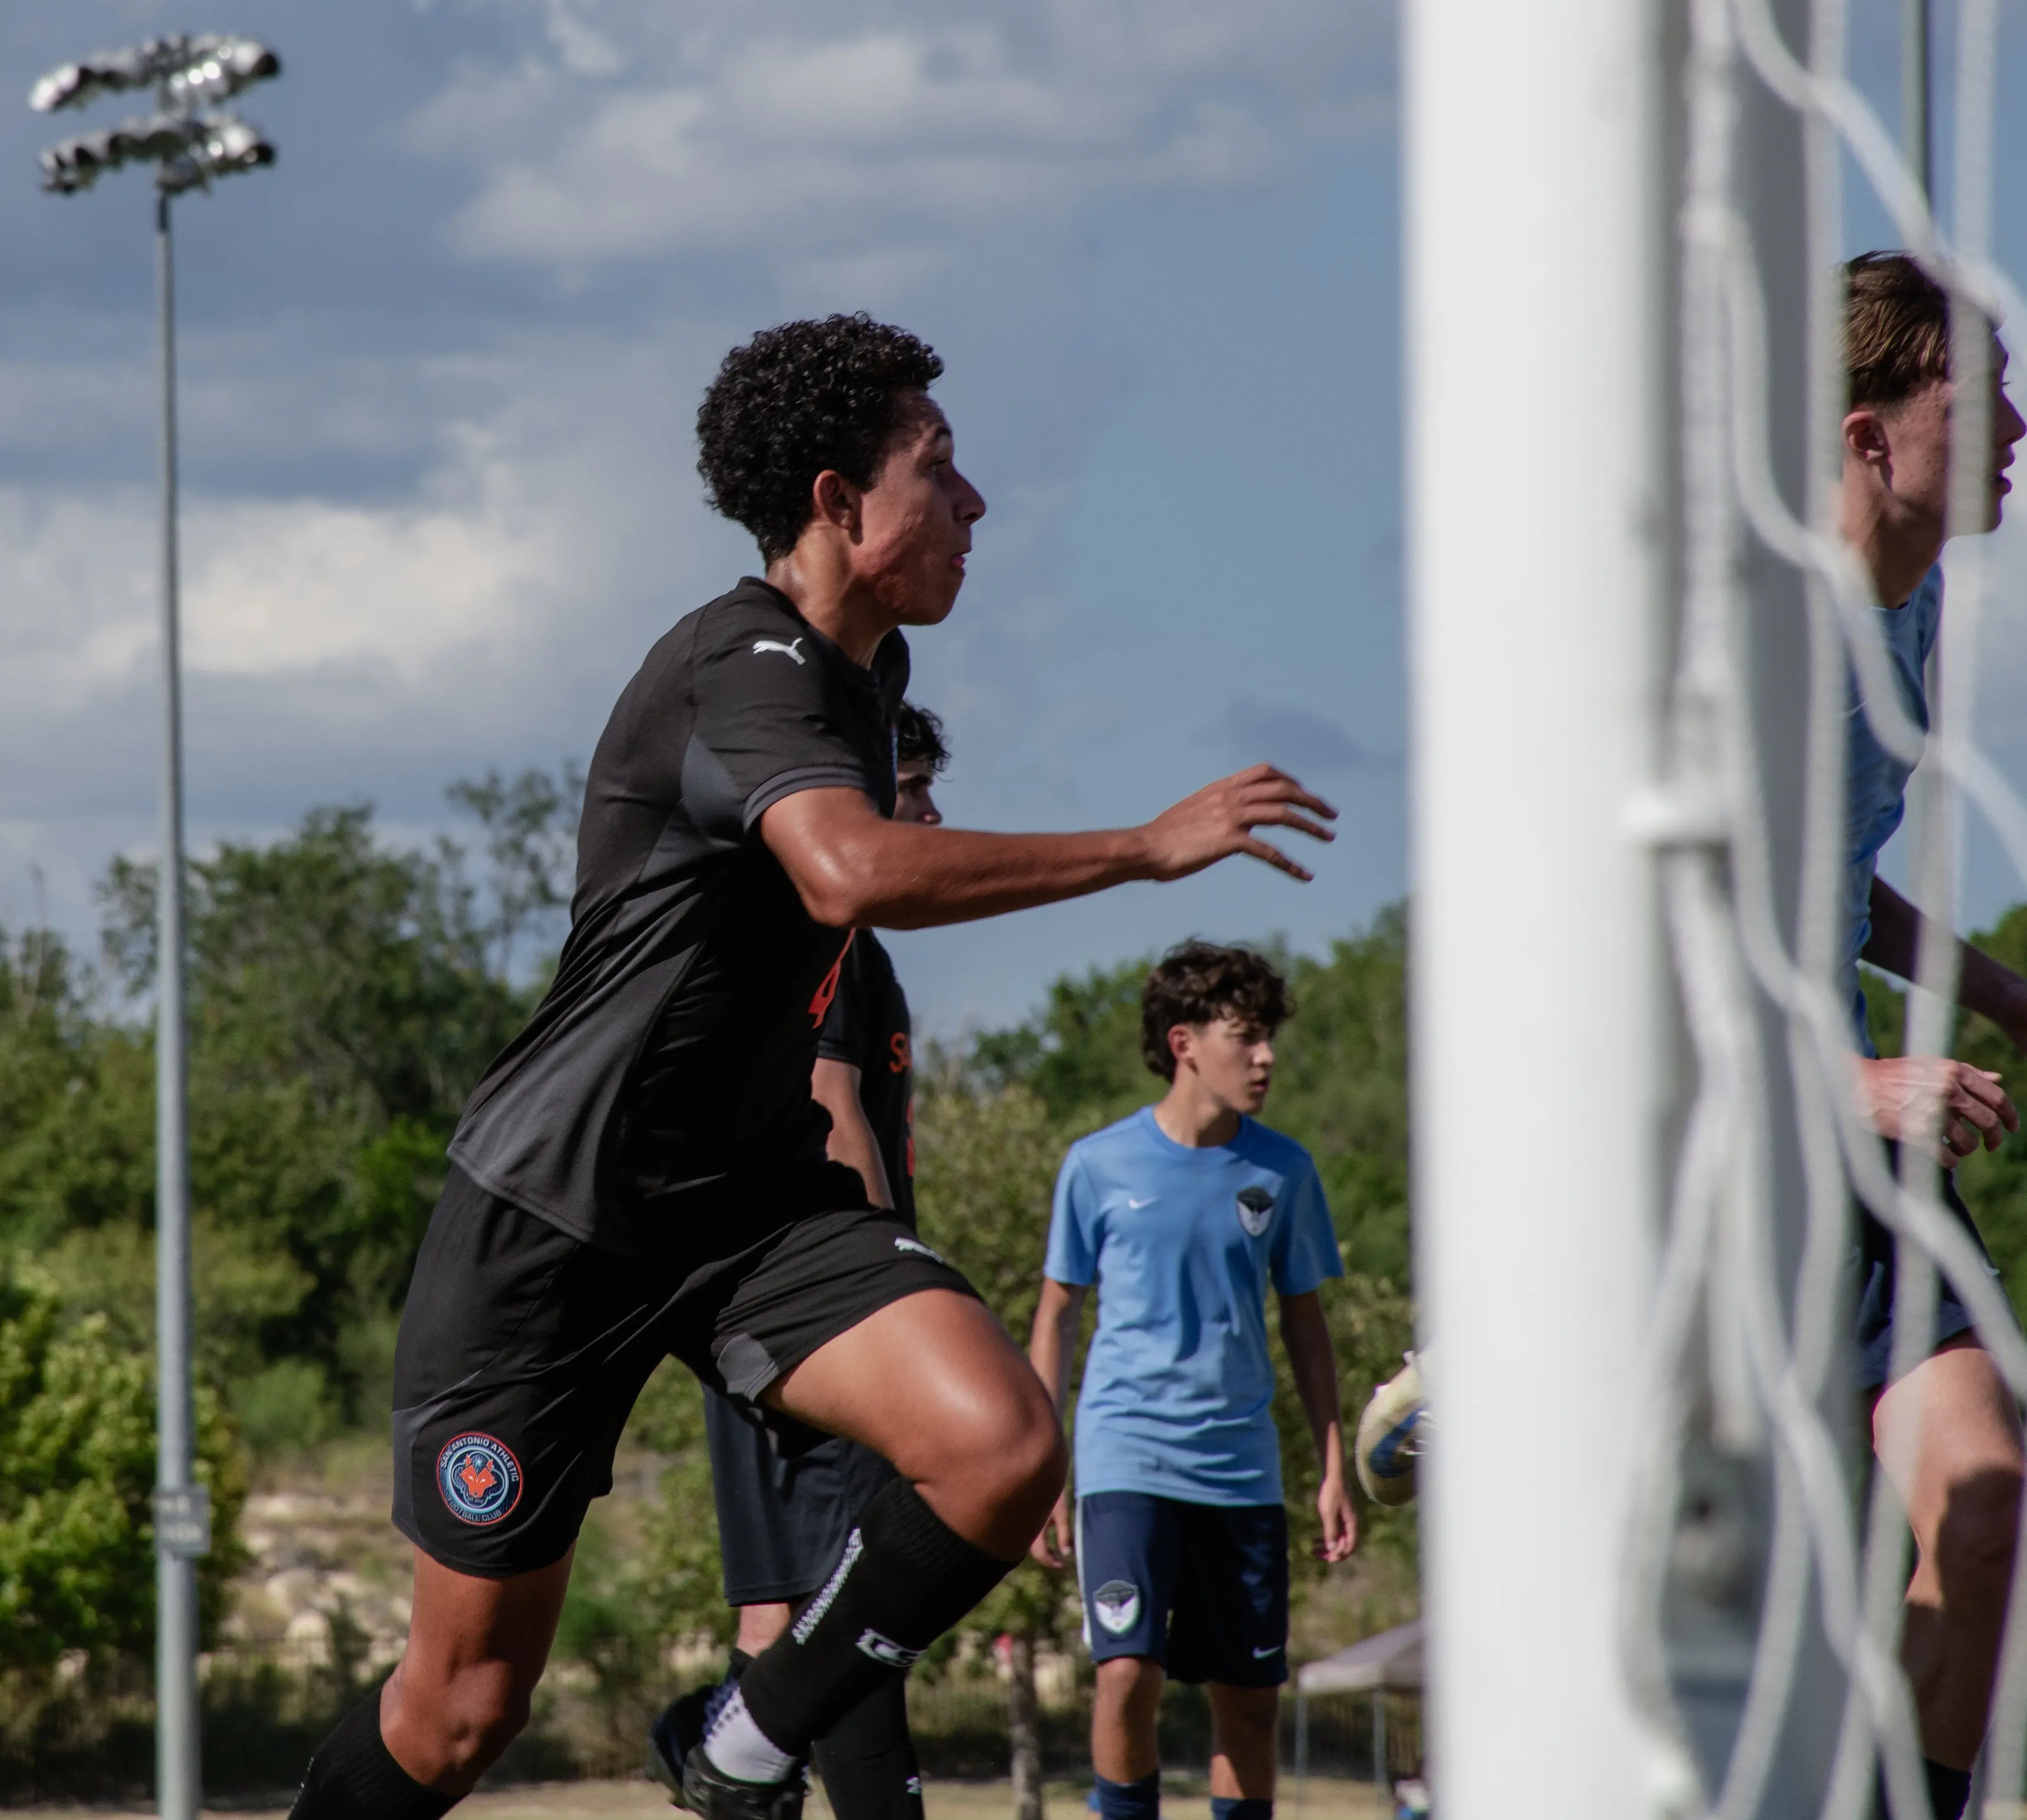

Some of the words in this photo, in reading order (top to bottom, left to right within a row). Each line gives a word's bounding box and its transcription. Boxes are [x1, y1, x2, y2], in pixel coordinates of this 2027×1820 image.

[440, 1447, 454, 1468] SAN
[453, 1436, 490, 1451] ANTONIO
[491, 1444, 519, 1482] ATHLETIC
[447, 1498, 480, 1522] FOOTBALL
[481, 1509, 501, 1522] CLUB
